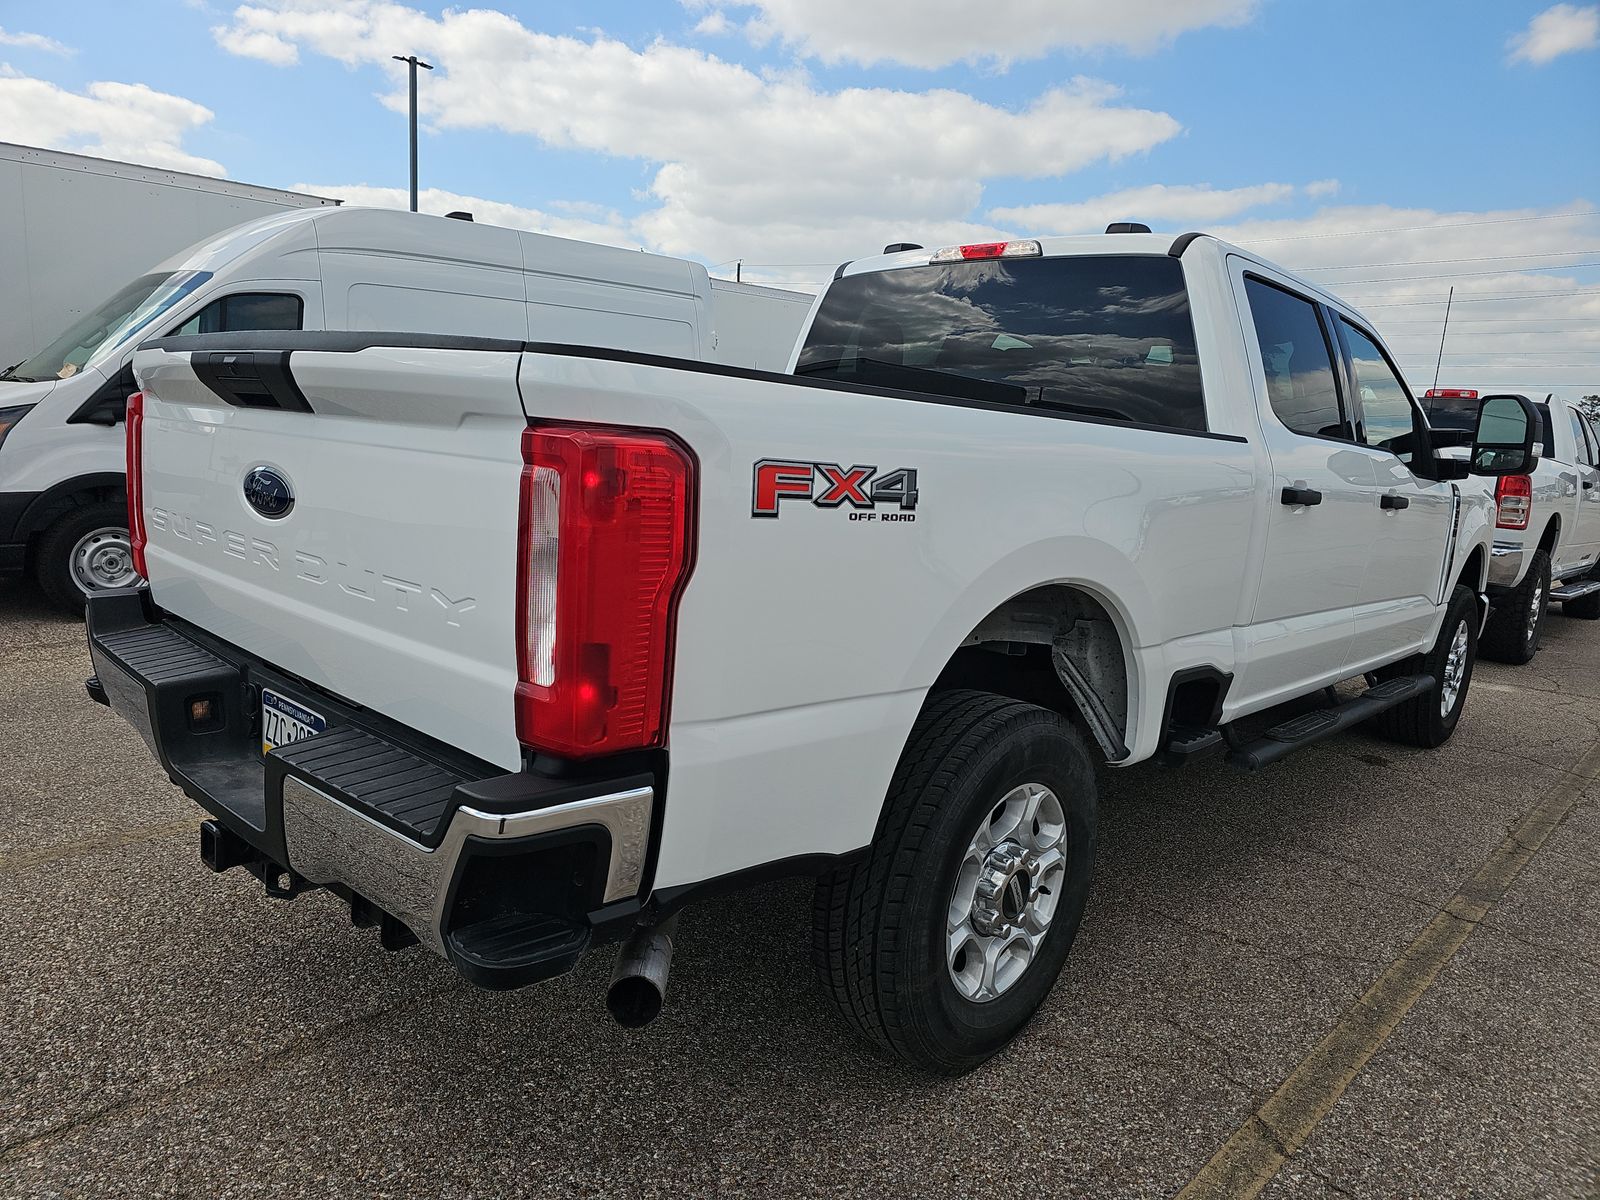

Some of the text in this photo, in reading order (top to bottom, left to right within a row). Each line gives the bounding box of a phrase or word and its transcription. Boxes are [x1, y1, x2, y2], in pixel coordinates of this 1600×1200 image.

[751, 458, 918, 518] FX4
[849, 512, 916, 522] OFF ROAD
[151, 506, 477, 628] SUPER DUTY
